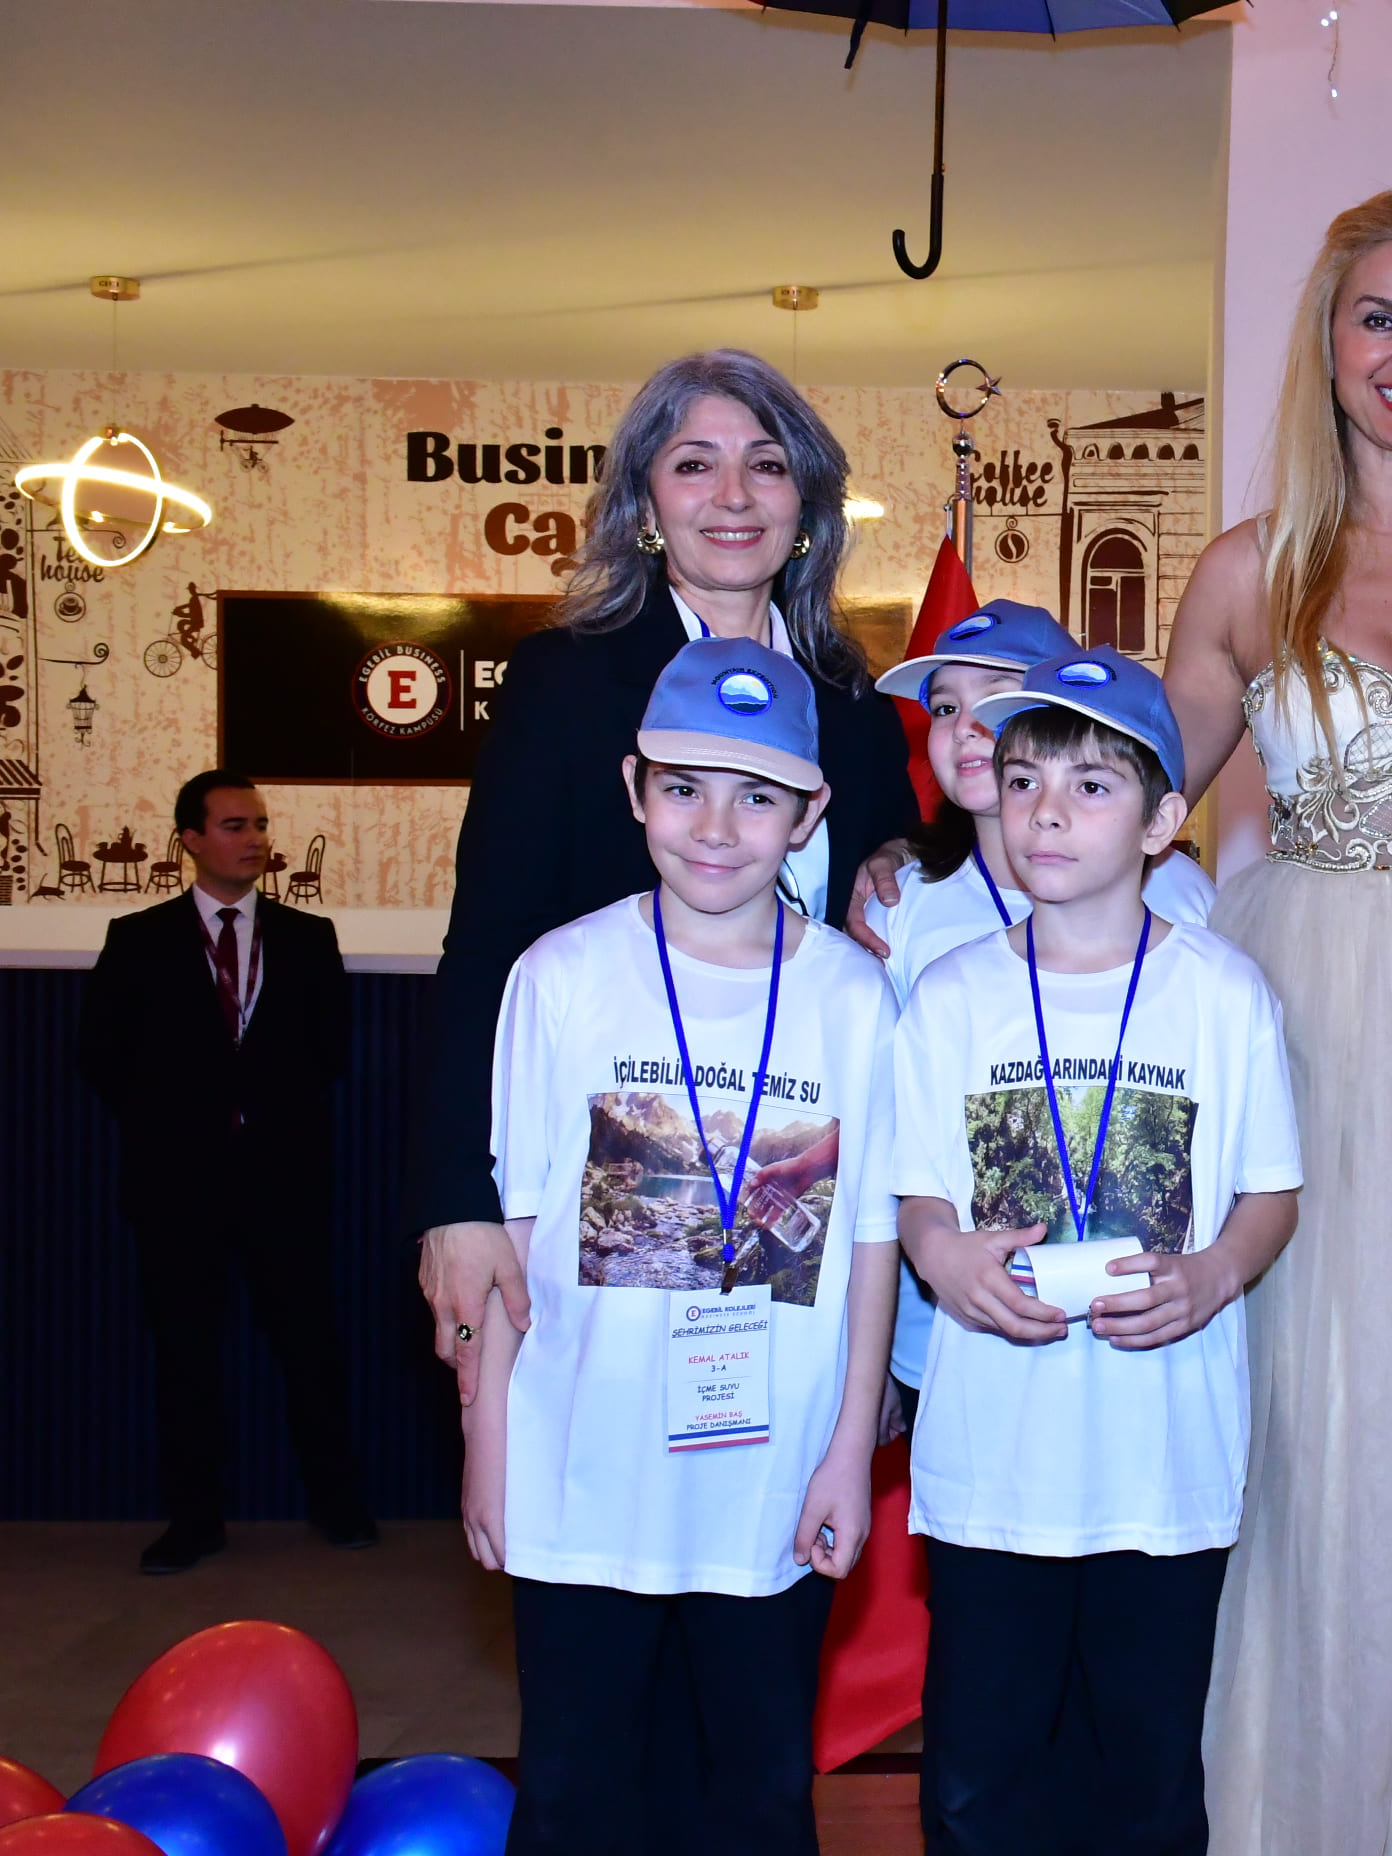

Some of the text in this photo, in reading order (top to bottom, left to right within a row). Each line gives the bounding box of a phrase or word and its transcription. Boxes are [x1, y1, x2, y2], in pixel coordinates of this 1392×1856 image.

[41, 554, 105, 583] house
[396, 645, 446, 684] BUSINESS
[387, 670, 417, 709] E
[360, 707, 396, 735] KÖRFEZ
[694, 1061, 746, 1092] DOĞAL
[799, 1080, 821, 1105] SU
[990, 1054, 1187, 1091] KAZDAĞARINDAİ KAYNAK
[688, 1351, 750, 1364] KEMAL ATALIK
[702, 1390, 735, 1402] PROJESİ
[719, 1382, 740, 1392] SUYU
[686, 1421, 708, 1431] PROJE
